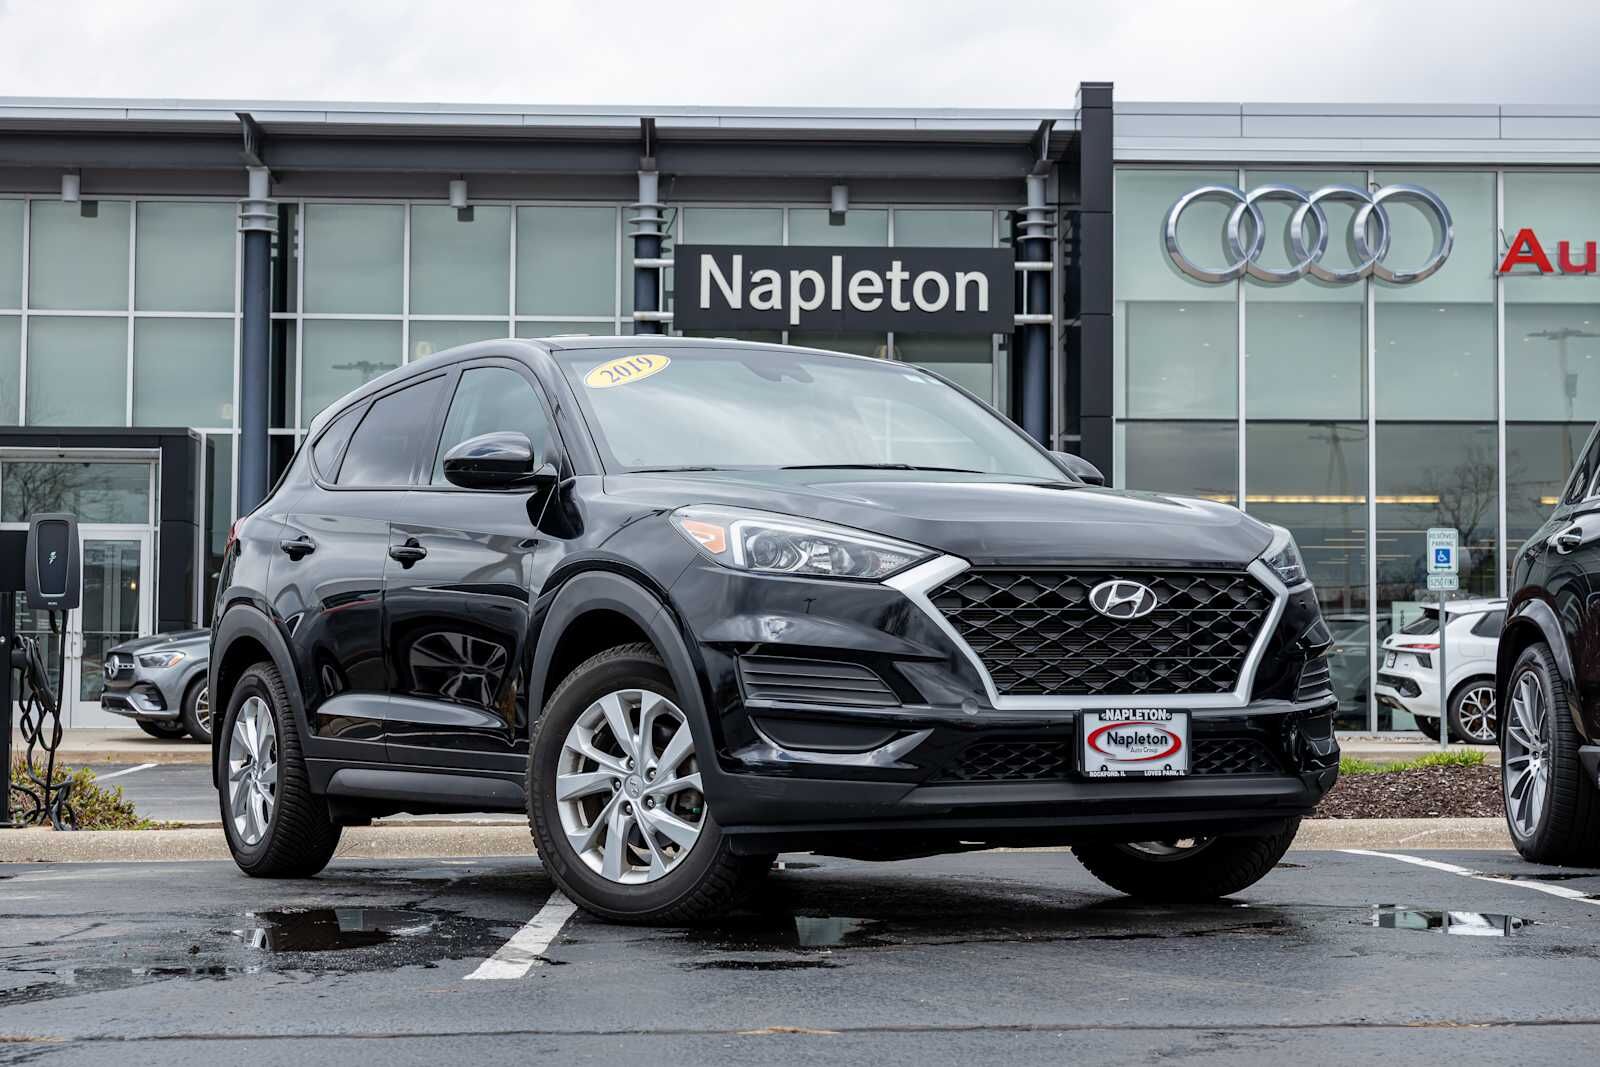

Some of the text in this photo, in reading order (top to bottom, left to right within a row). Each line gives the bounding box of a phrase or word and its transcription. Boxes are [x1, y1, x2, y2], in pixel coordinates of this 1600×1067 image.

[1499, 228, 1597, 272] Au
[700, 254, 989, 325] Napleton
[600, 356, 653, 383] 2019
[1105, 709, 1166, 720] NAPLETON
[1107, 731, 1168, 748] Napleton
